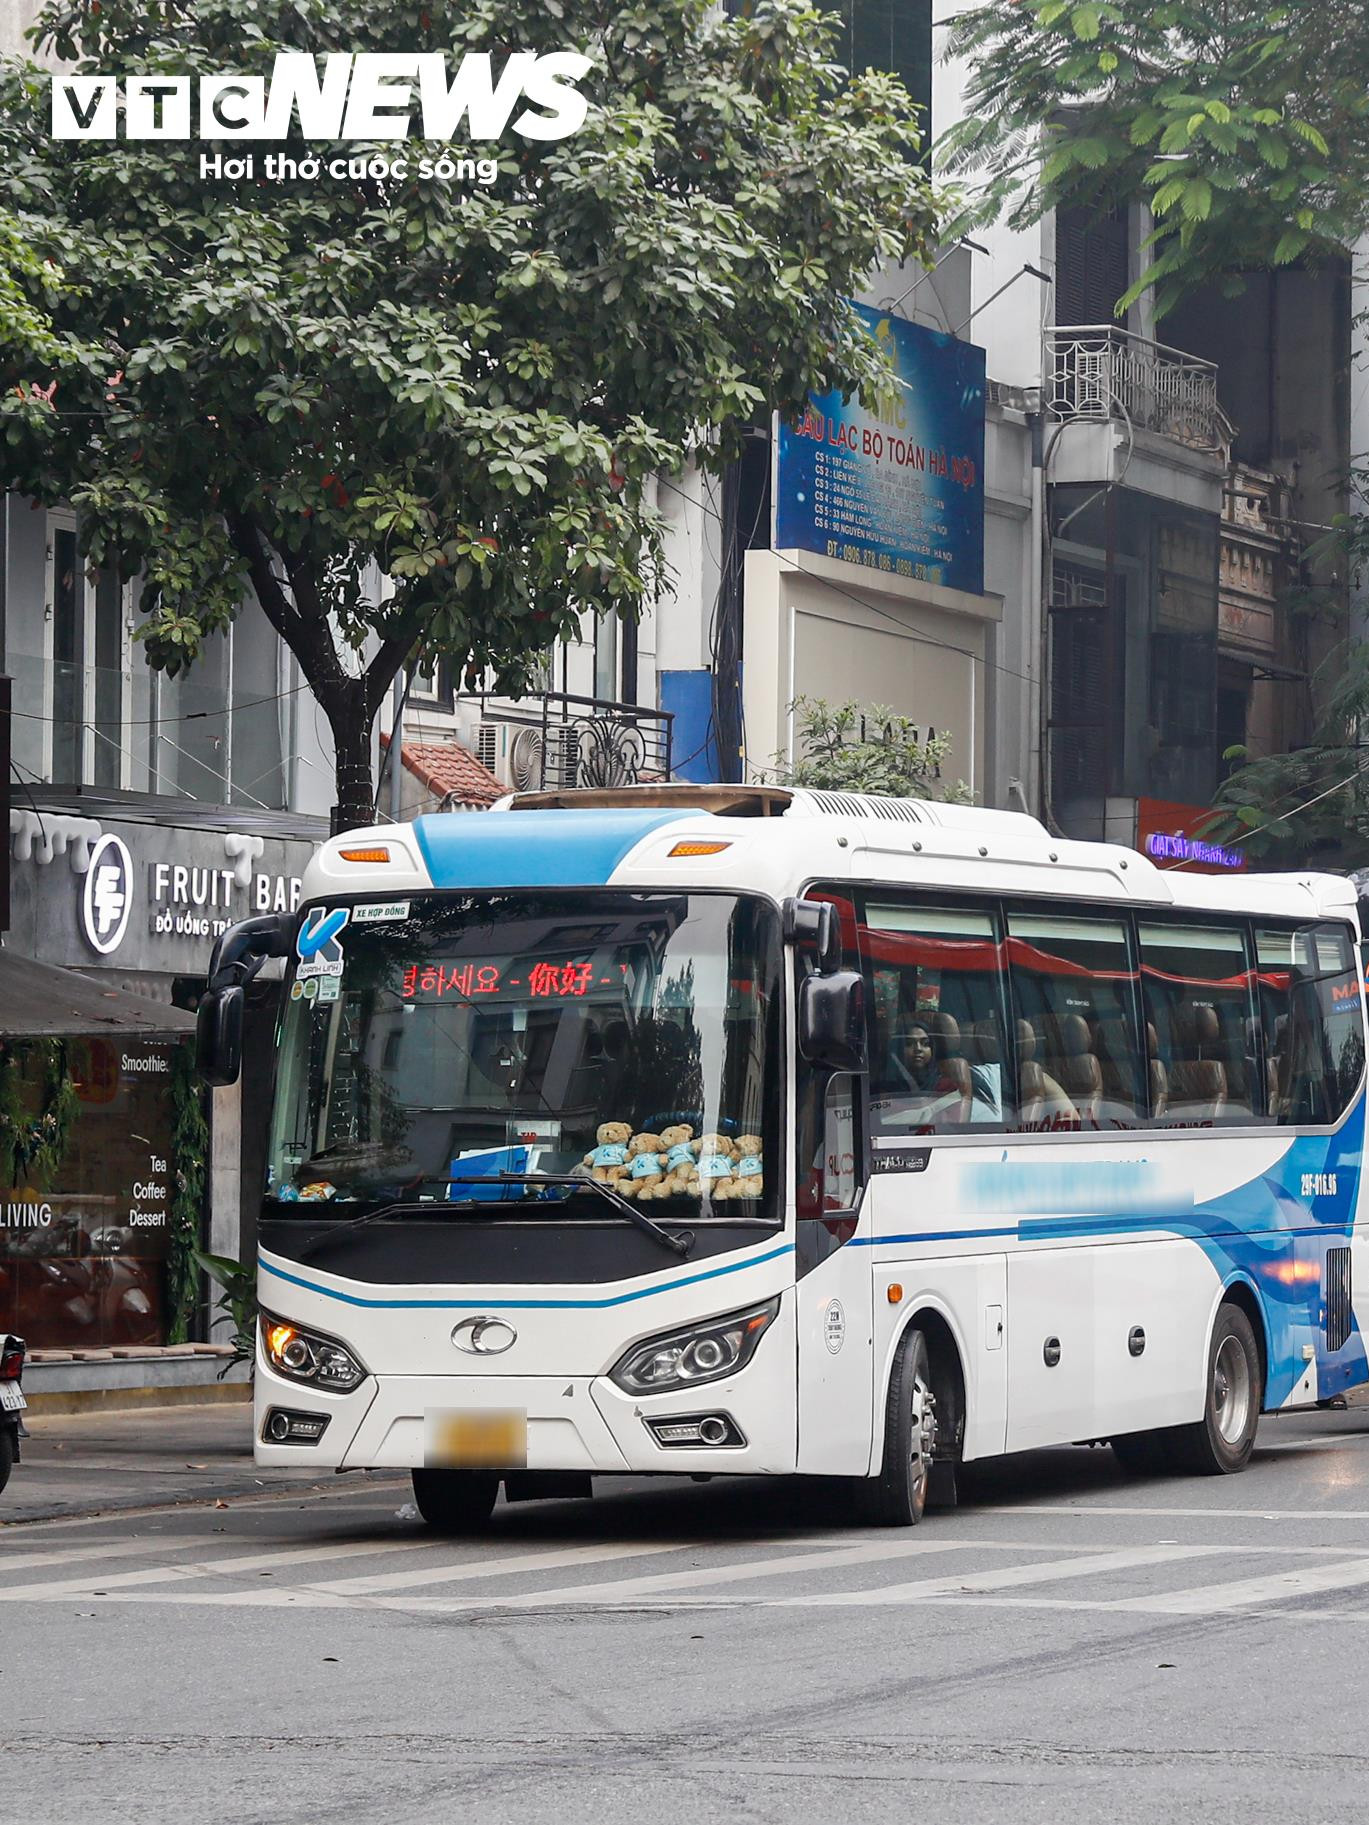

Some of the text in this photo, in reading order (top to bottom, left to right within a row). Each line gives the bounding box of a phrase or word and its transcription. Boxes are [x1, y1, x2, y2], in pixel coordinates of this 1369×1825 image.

[828, 418, 858, 453] LẠC
[862, 428, 883, 465] BỘ
[887, 436, 925, 472] TOÁN
[155, 863, 303, 913] FRUIT BAR
[156, 908, 173, 933] ĐỒ
[176, 910, 210, 936] UỐNG
[356, 909, 366, 918] XE
[528, 961, 593, 997] 你好
[150, 1155, 167, 1172] Tea
[133, 1182, 167, 1199] Coffee
[130, 1209, 166, 1226] Dessert
